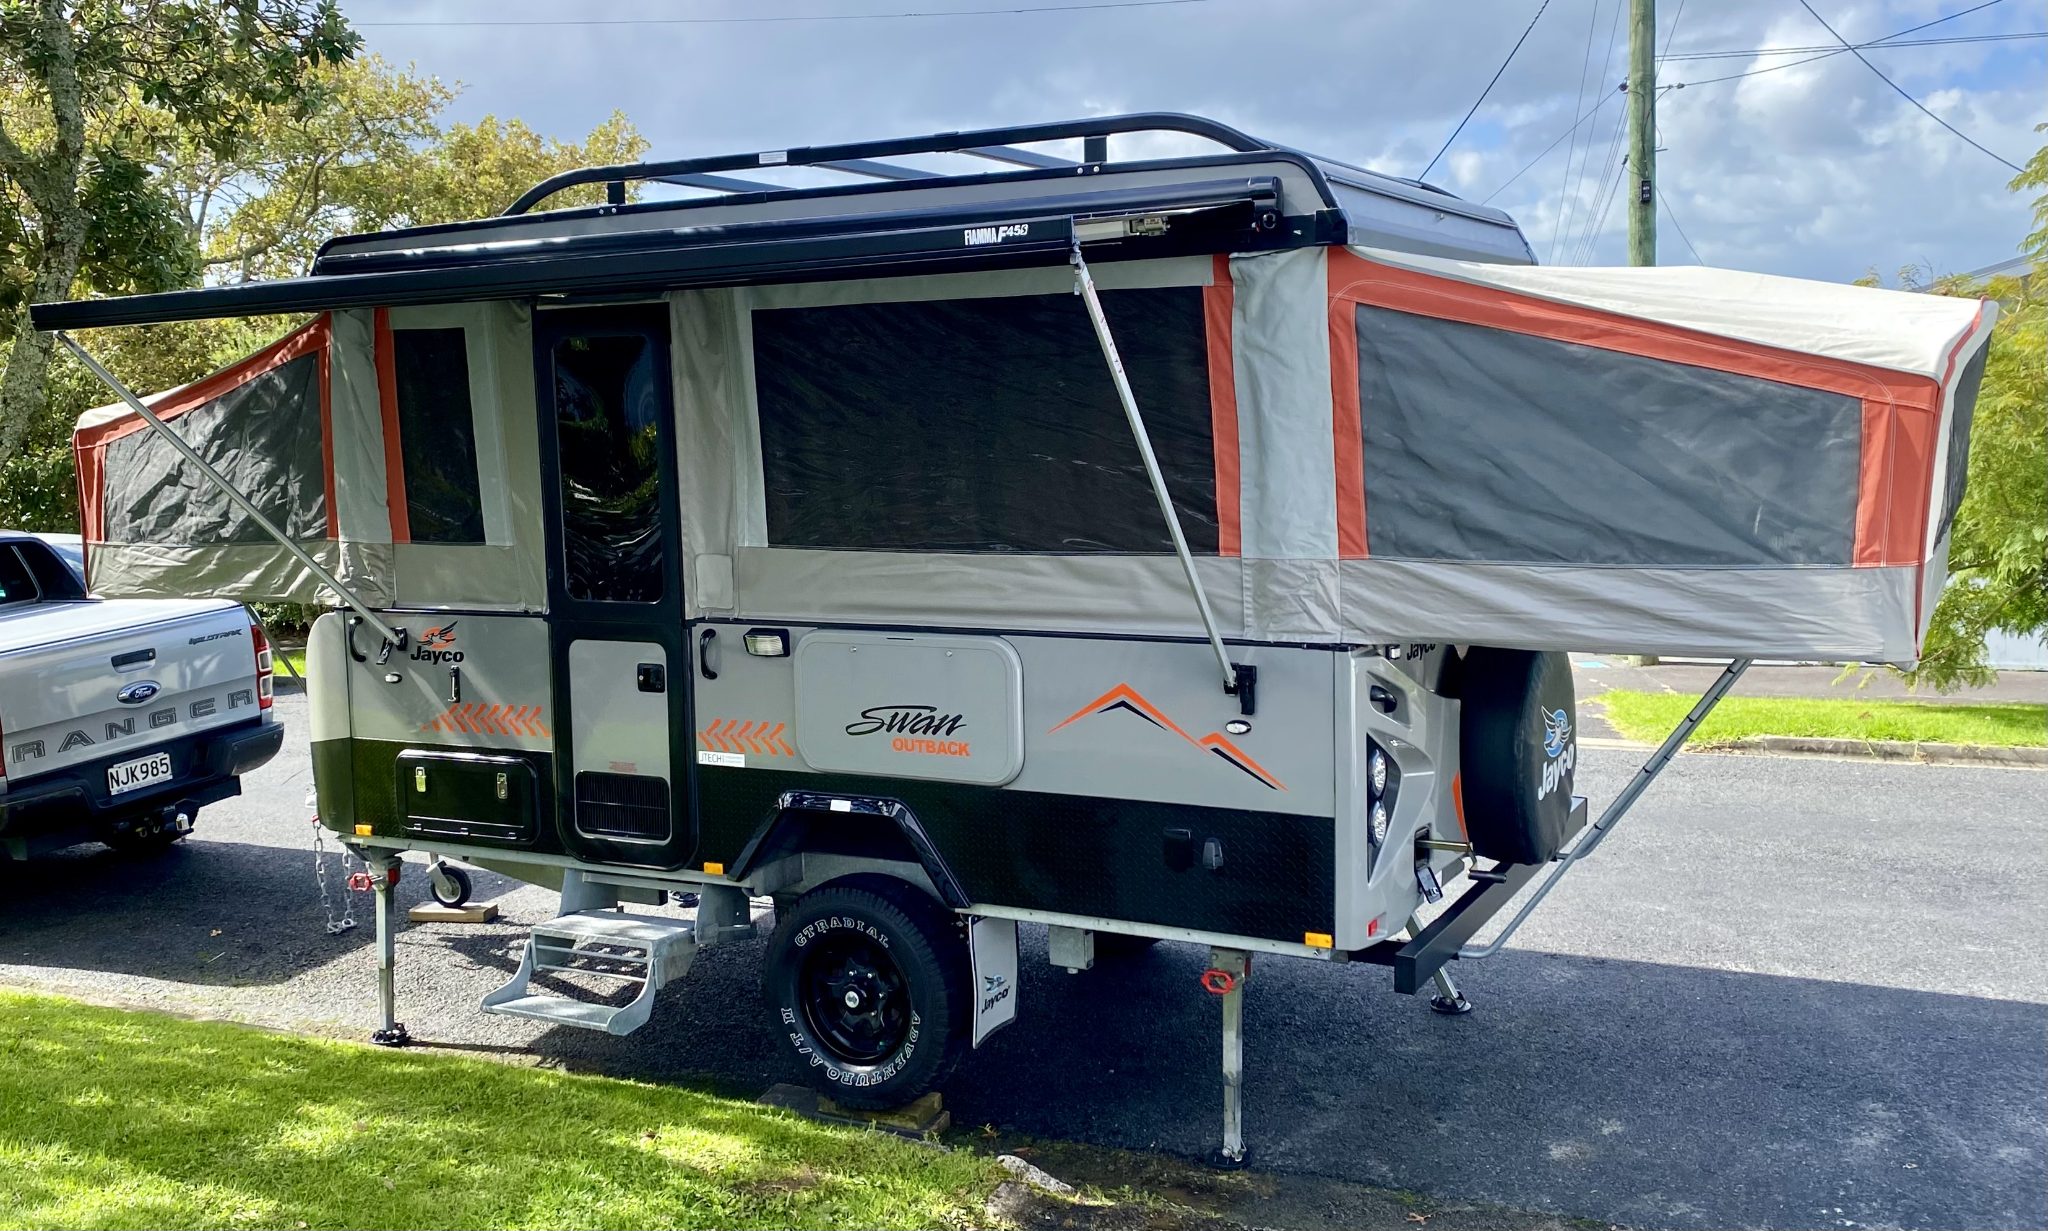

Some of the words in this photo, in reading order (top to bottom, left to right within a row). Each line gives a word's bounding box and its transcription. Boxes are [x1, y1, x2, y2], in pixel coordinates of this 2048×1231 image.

[964, 227, 997, 246] FIAMMA
[410, 646, 464, 665] Jayco
[134, 686, 152, 699] Ford
[12, 688, 253, 764] RANGER
[845, 705, 967, 736] Swan
[892, 738, 971, 757] OUTBACK
[109, 757, 170, 789] NJK985
[1538, 743, 1575, 801] Jayco
[981, 987, 1009, 1014] Jayco
[790, 1032, 824, 1067] A/T
[826, 1010, 921, 1087] ADVENTURO
